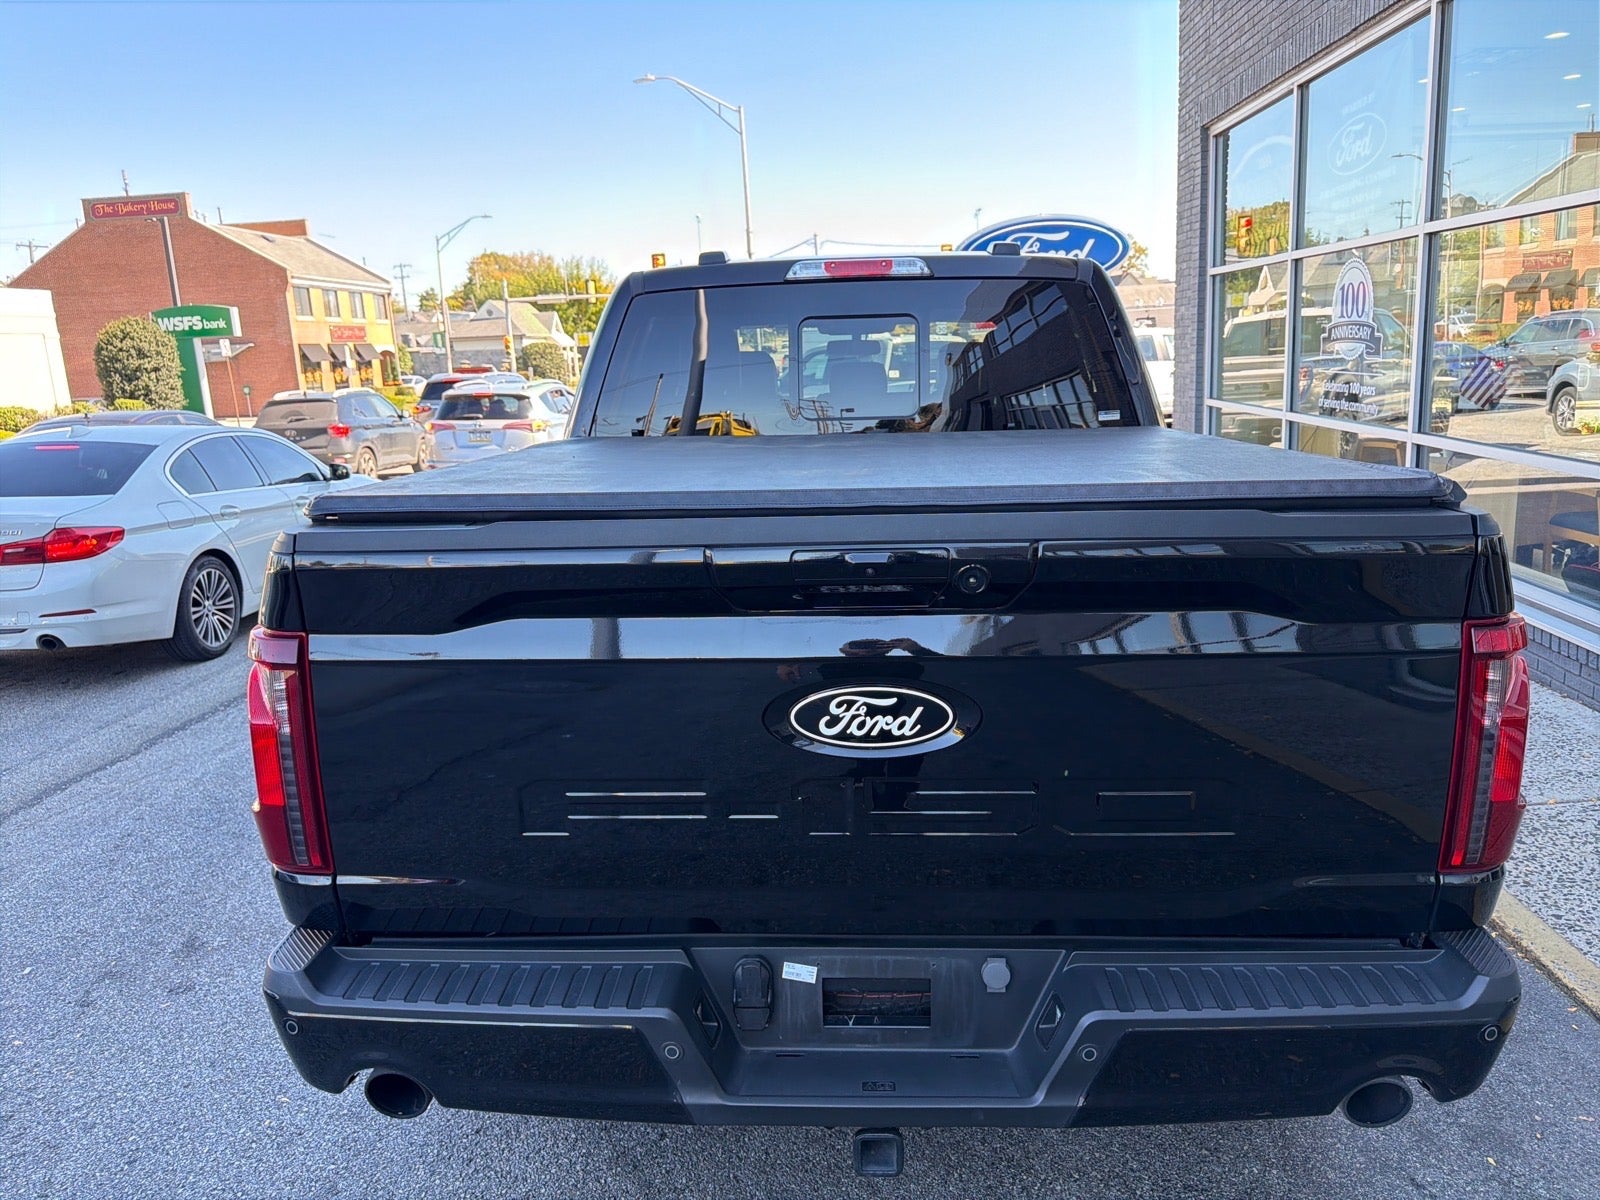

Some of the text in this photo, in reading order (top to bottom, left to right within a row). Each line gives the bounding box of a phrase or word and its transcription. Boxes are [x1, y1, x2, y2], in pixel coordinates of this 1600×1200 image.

[94, 200, 175, 217] The Bakery House
[1338, 280, 1367, 319] 100
[157, 315, 227, 331] WSFS bank
[1330, 325, 1372, 340] ANNIVERSARY
[1349, 382, 1361, 395] 100
[1359, 385, 1376, 398] years
[1349, 401, 1379, 417] community
[818, 695, 924, 737] Ford
